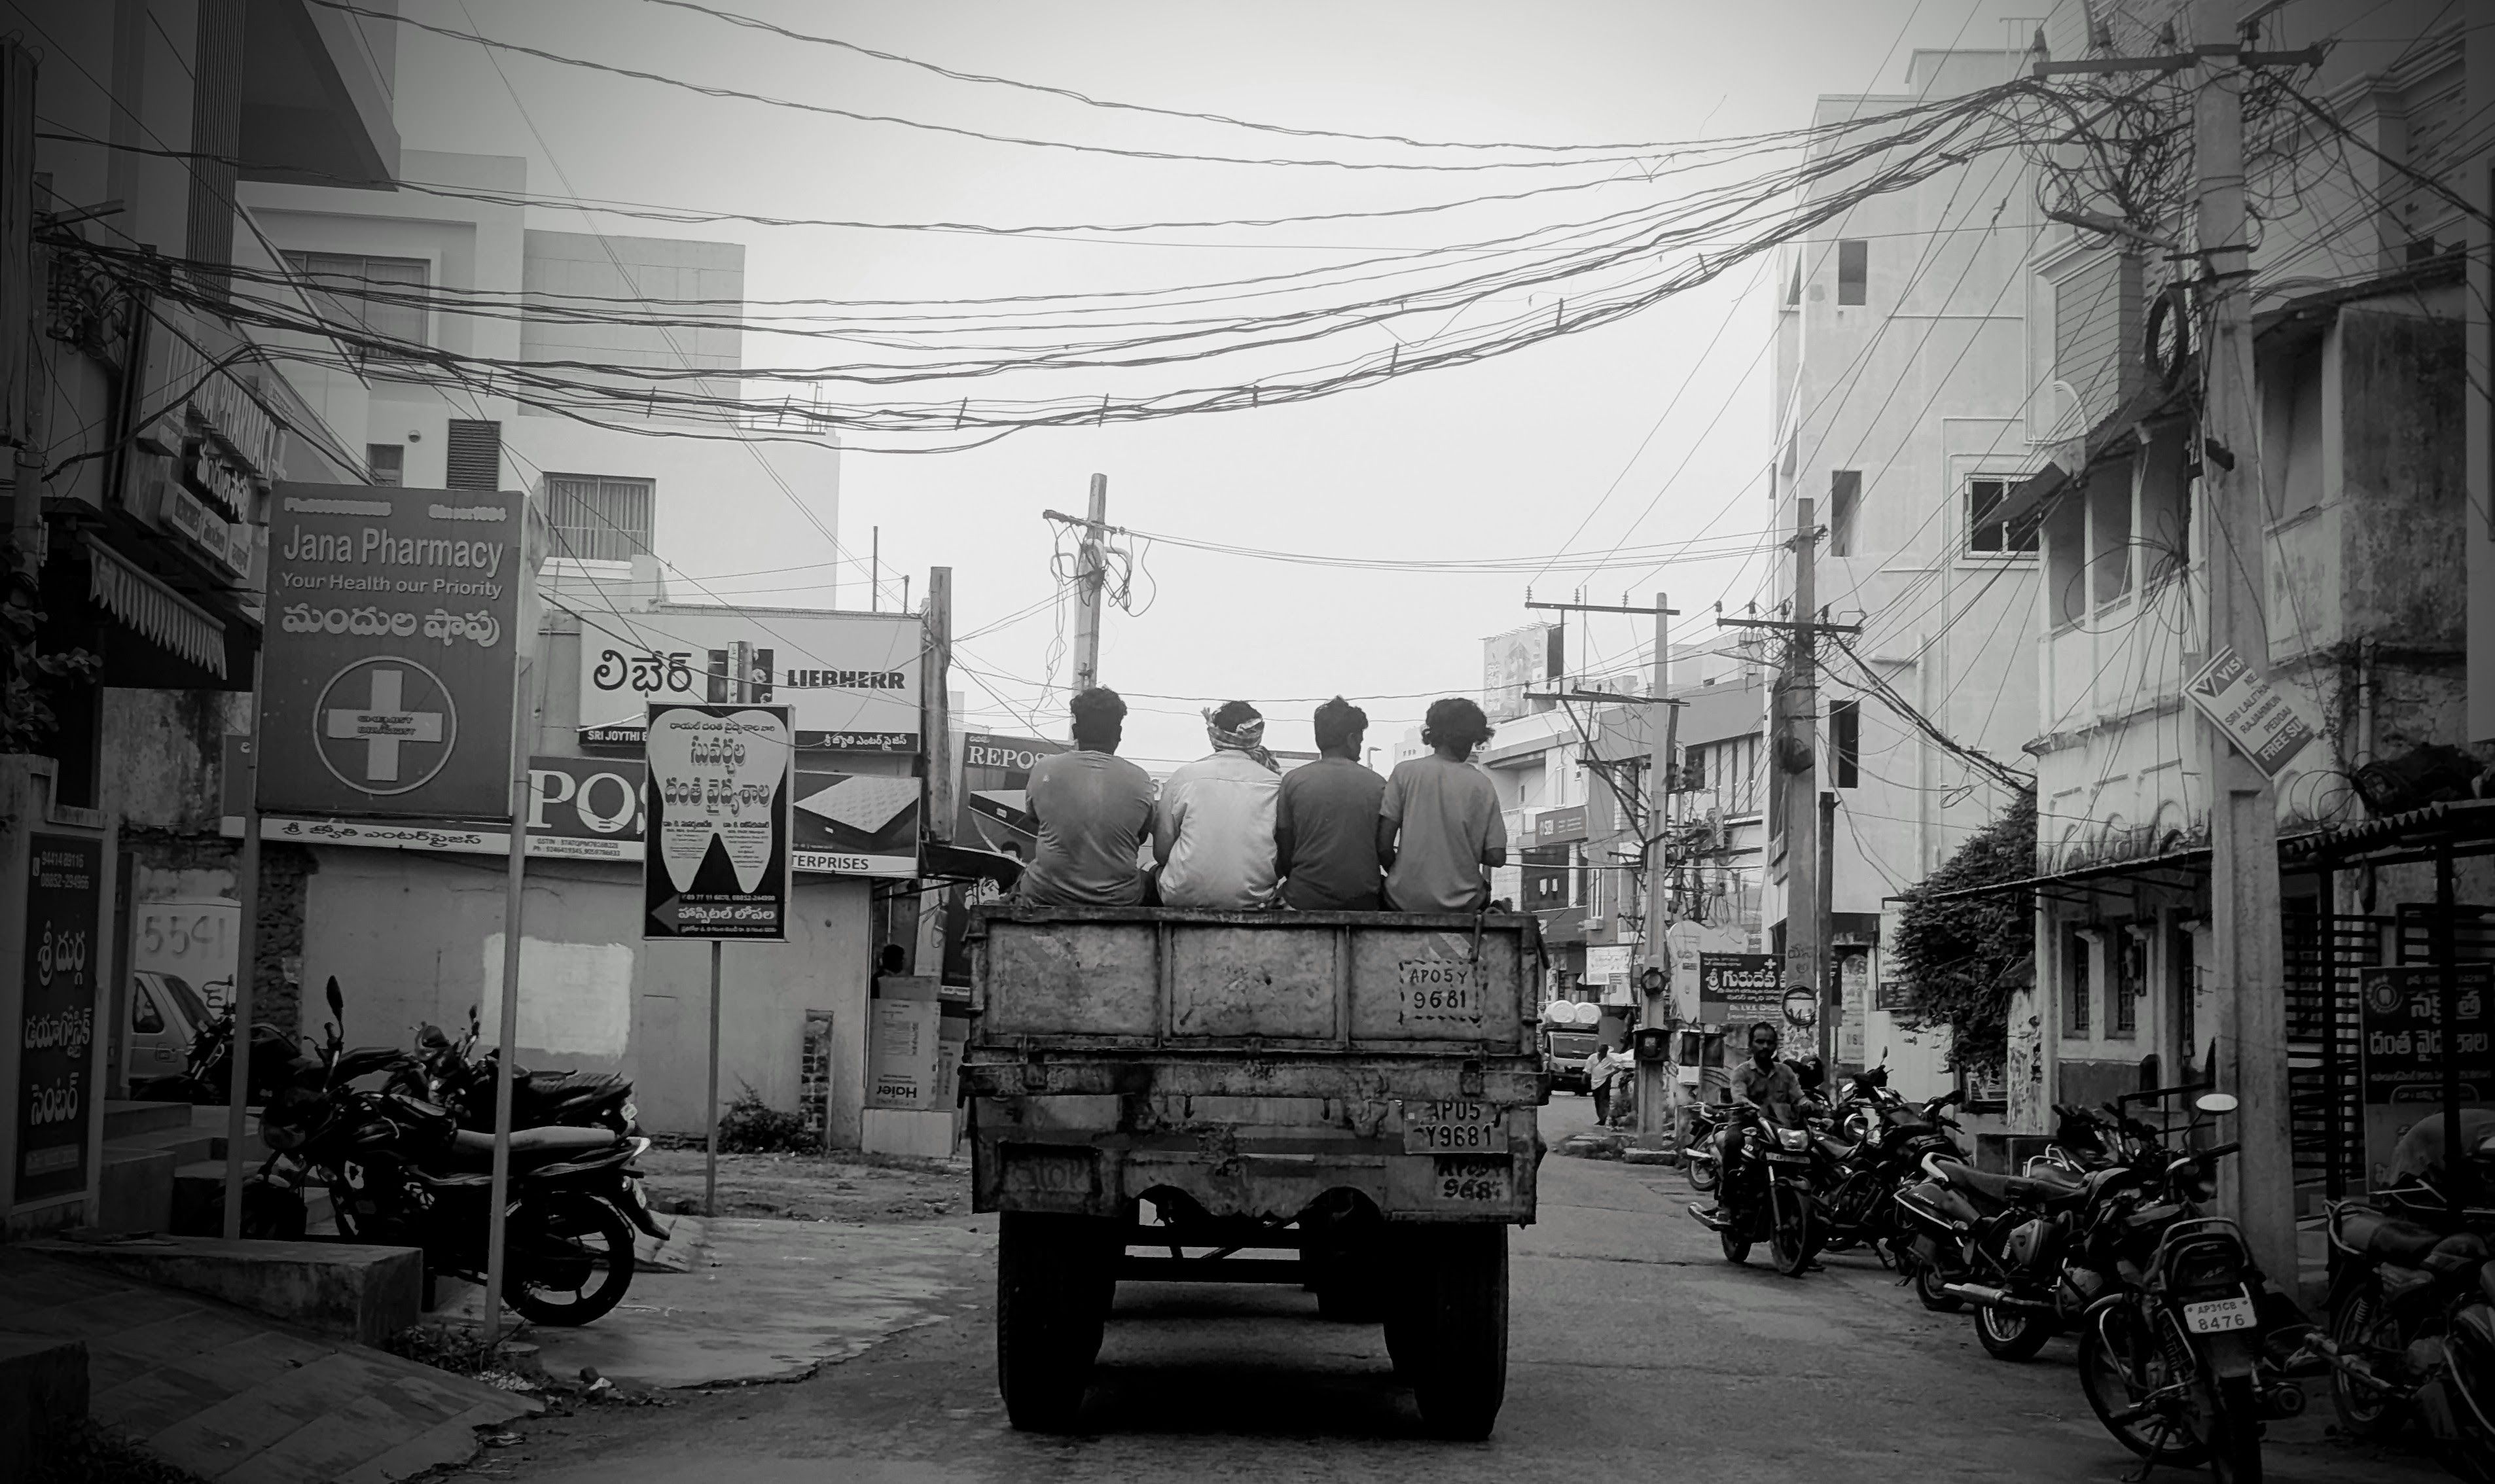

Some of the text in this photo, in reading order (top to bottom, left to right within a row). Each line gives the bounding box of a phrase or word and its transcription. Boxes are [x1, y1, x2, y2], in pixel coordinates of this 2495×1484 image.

[283, 524, 351, 562] Jana
[362, 527, 503, 578] Pharmacy
[281, 572, 503, 599] Your Health our Priority
[282, 603, 501, 647] మందుల షాపు
[788, 669, 905, 689] LIEBHERR
[2225, 711, 2241, 726] SRI
[588, 731, 603, 741] SRI
[605, 732, 639, 741] JOYTHI
[2261, 732, 2290, 761] FREE
[283, 822, 302, 835] శ్రీ
[310, 824, 359, 839] జ్యోతి
[1409, 970, 1467, 985] AP05Y
[1414, 990, 1466, 1008] 9681
[876, 1086, 916, 1098] Haier
[1426, 1125, 1492, 1147] Y9681
[2198, 1314, 2245, 1330] 8476
